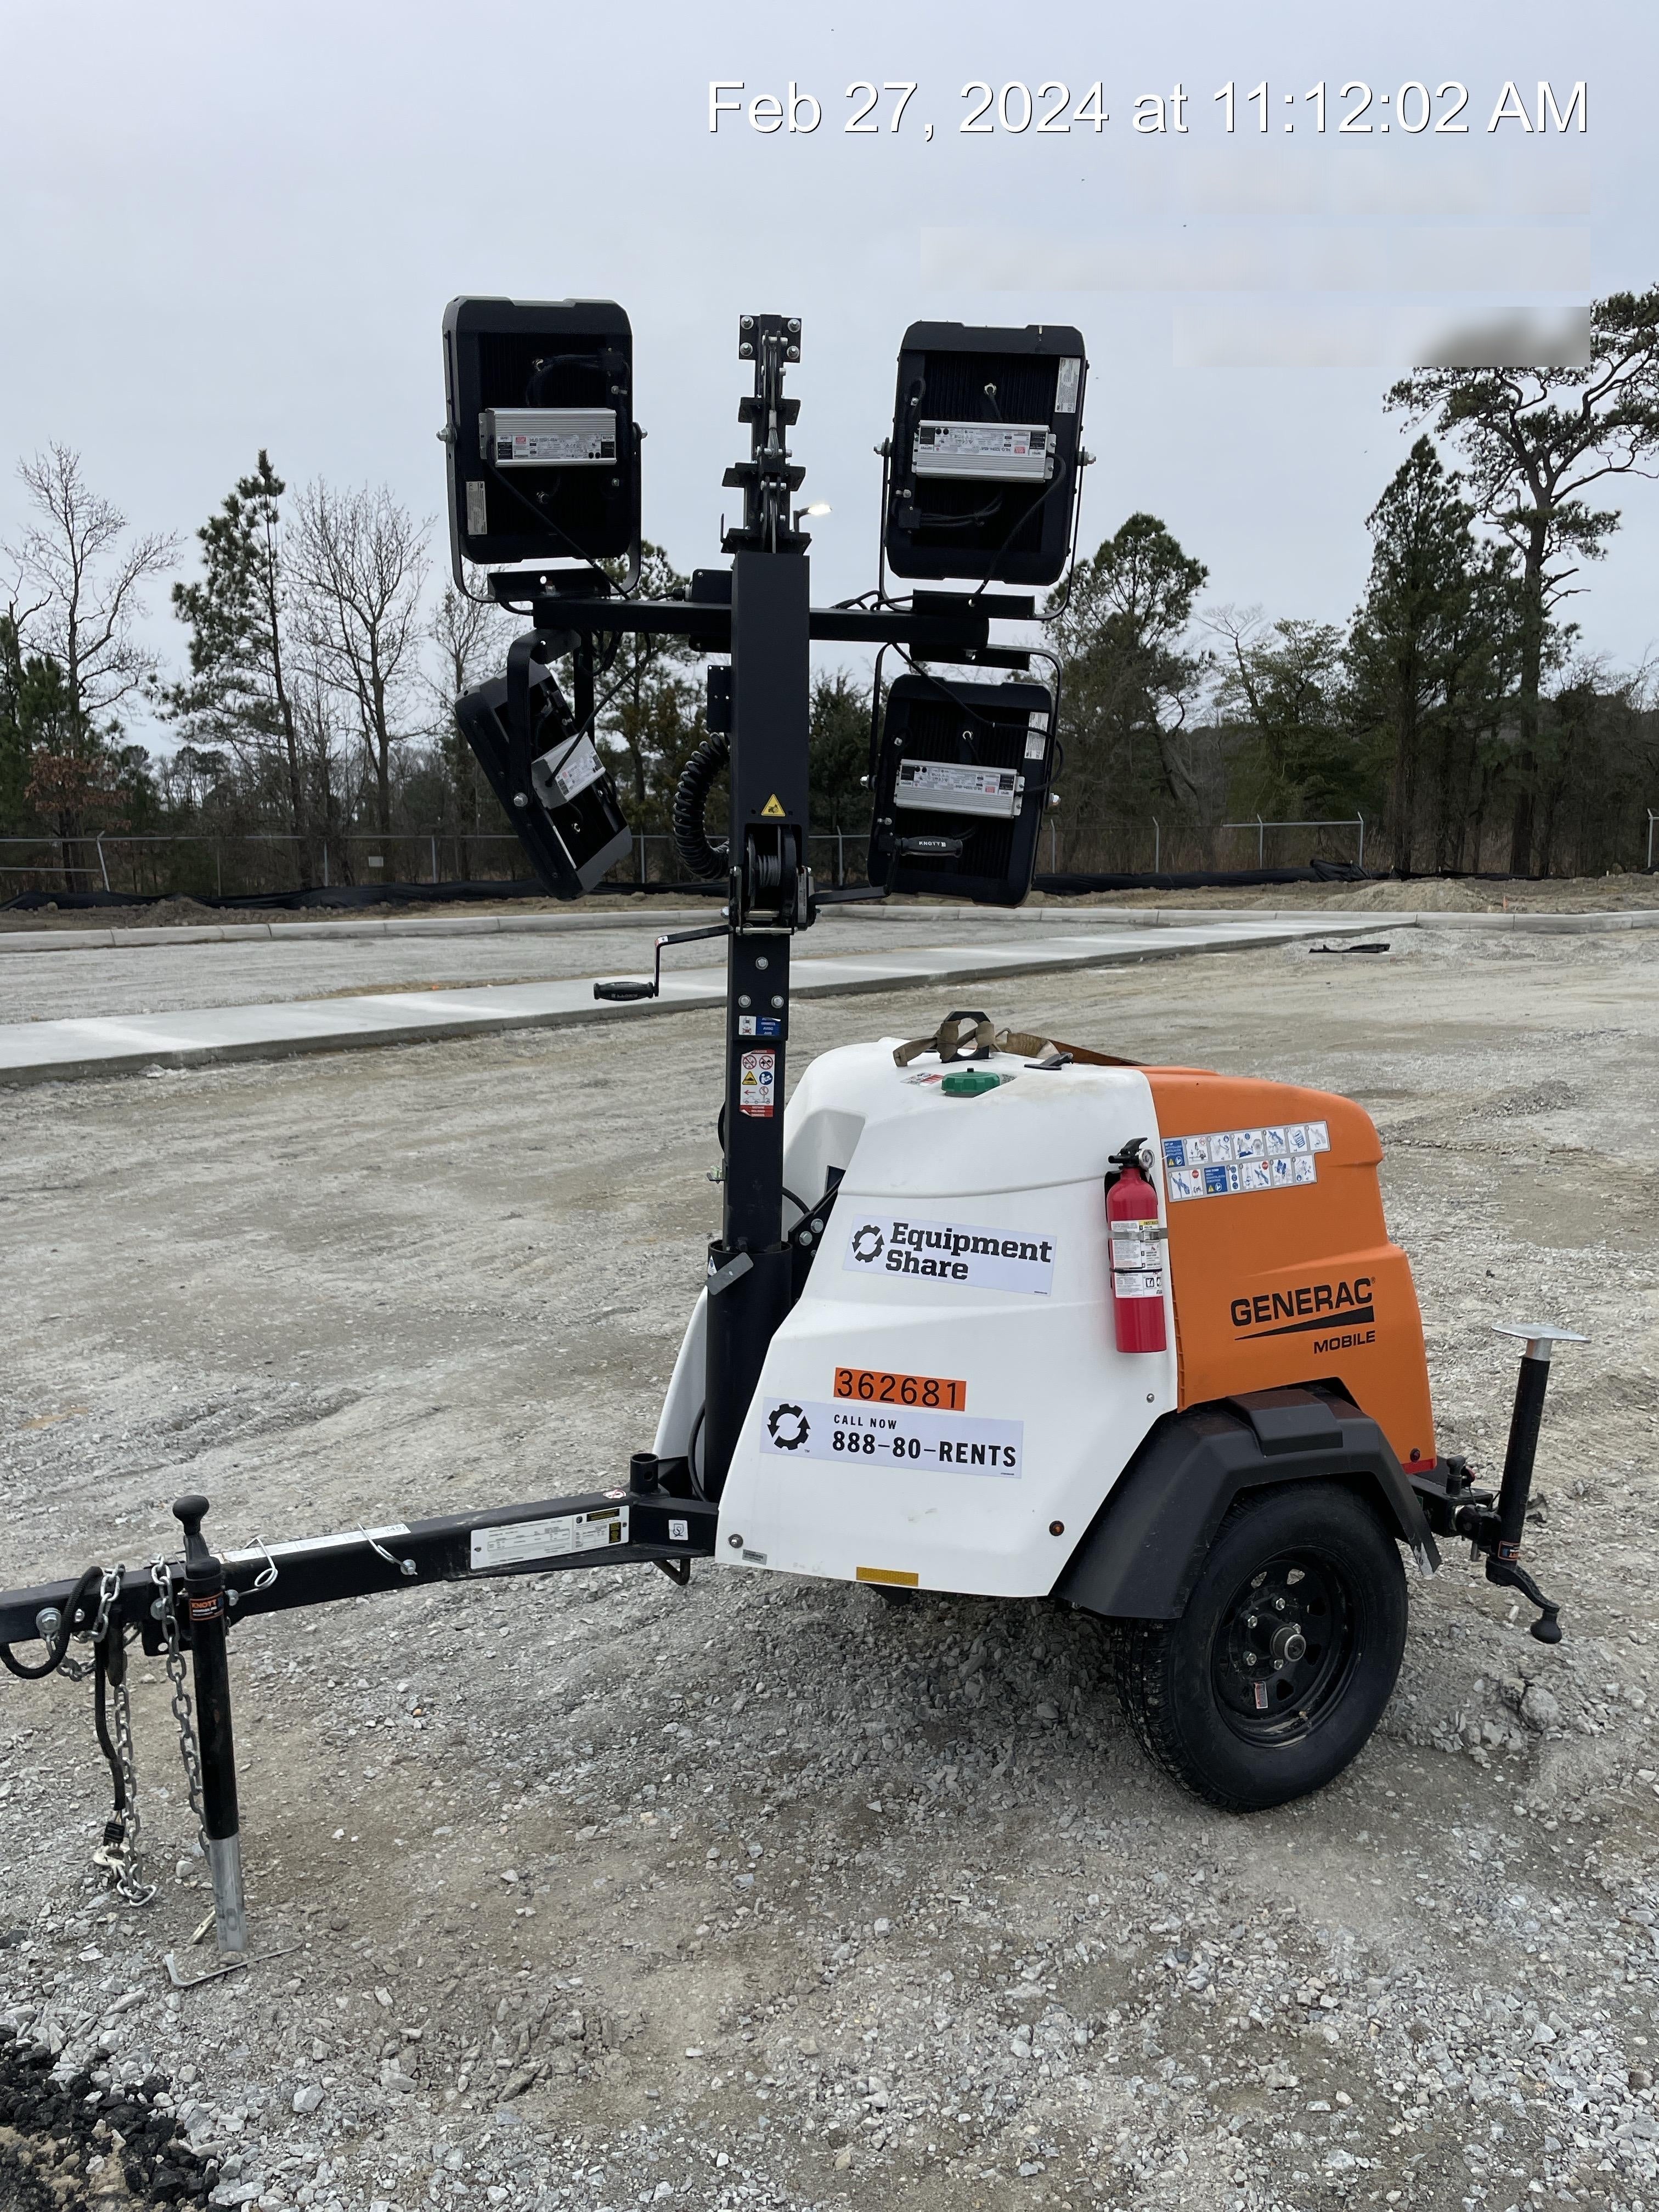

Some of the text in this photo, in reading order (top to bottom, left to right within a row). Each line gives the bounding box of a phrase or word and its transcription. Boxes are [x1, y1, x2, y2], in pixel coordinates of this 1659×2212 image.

[890, 1222, 1052, 1263] Equipment
[885, 1250, 969, 1280] Share
[1231, 1278, 1373, 1327] GENERAC
[1313, 1330, 1375, 1355] MOBILE
[837, 1370, 956, 1408] 362681
[834, 1414, 897, 1430] CALL NOW
[832, 1430, 1016, 1467] 888-80-RENTS
